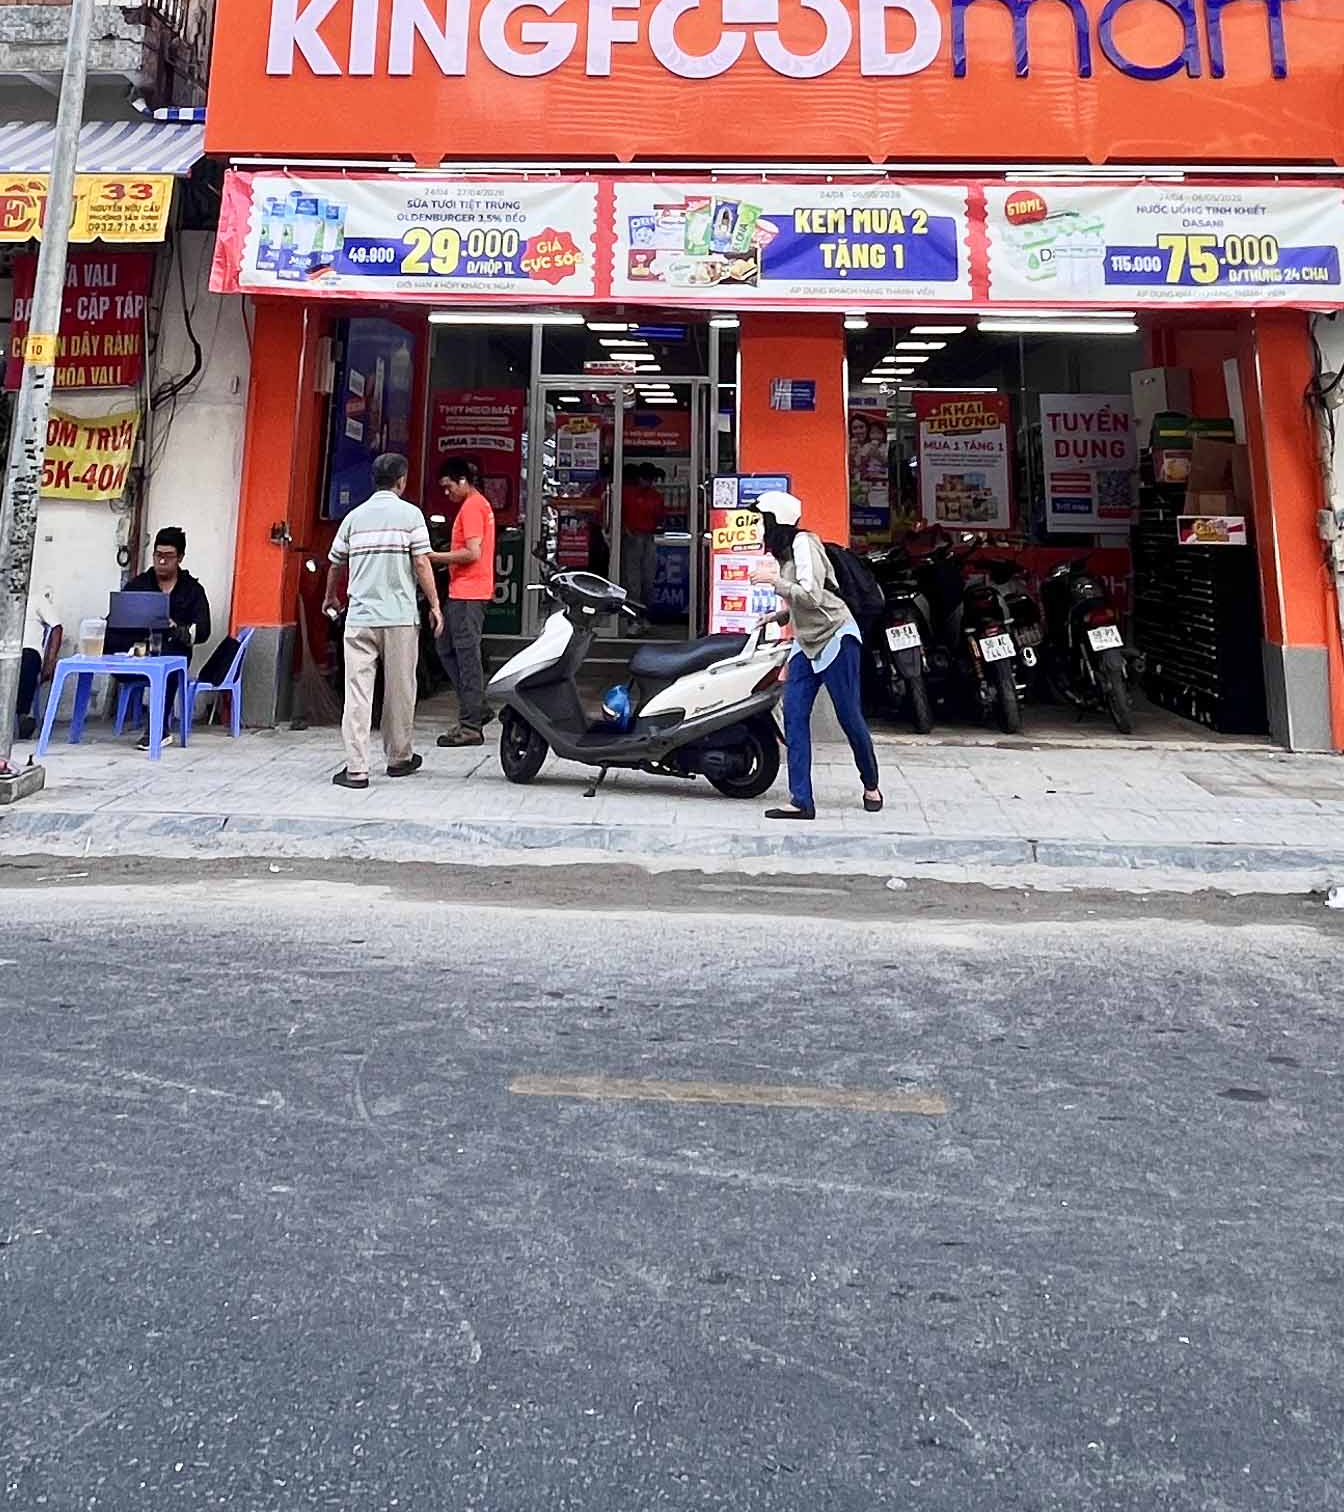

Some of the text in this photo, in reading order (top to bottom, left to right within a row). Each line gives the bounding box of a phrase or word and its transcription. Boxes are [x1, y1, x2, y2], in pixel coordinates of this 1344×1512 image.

[100, 183, 154, 201] 33
[794, 207, 929, 235] KEM MUA 2
[400, 226, 520, 275] 29.000
[819, 238, 905, 277] TẶNG 1
[1156, 233, 1279, 284] 75.000
[83, 263, 118, 287] VALI
[1283, 269, 1300, 282] 24
[1301, 266, 1329, 281] CHAI
[76, 291, 110, 326] CẶP
[115, 291, 144, 320] TÁP
[30, 344, 43, 355] 10
[70, 332, 101, 358] DÂY
[55, 365, 122, 386] HÓA VALI
[942, 401, 984, 417] KHAI
[1046, 403, 1130, 433] TUYỂN
[46, 417, 79, 448] ƠM
[1055, 438, 1126, 463] DỤNG
[40, 458, 129, 492] 5K-40K
